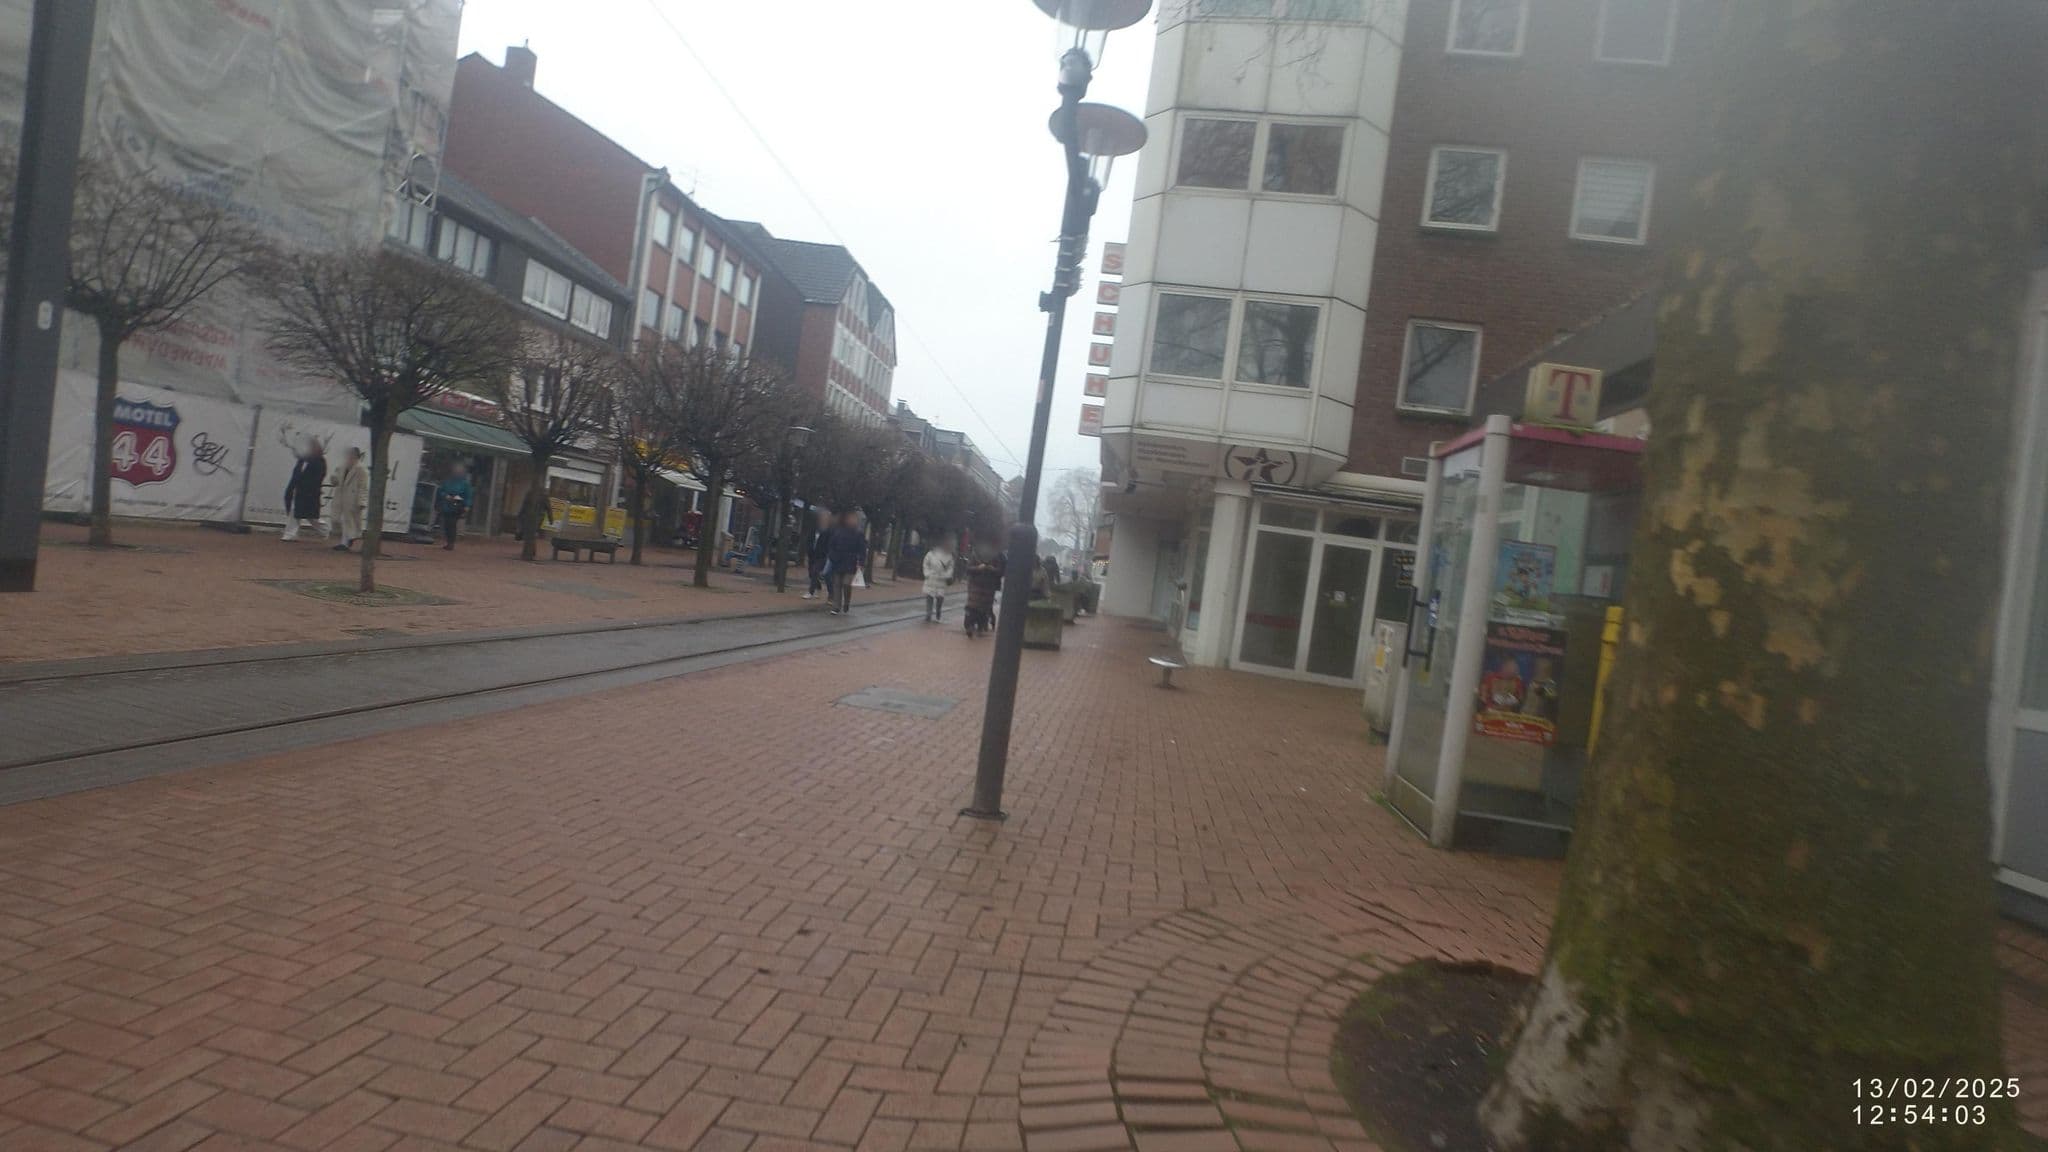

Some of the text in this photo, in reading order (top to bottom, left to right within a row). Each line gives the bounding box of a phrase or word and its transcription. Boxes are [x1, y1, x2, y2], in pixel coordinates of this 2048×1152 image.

[1082, 250, 1123, 425] SCHUHE
[112, 403, 174, 428] MOTEL
[1548, 368, 1592, 422] T
[112, 431, 171, 476] 44
